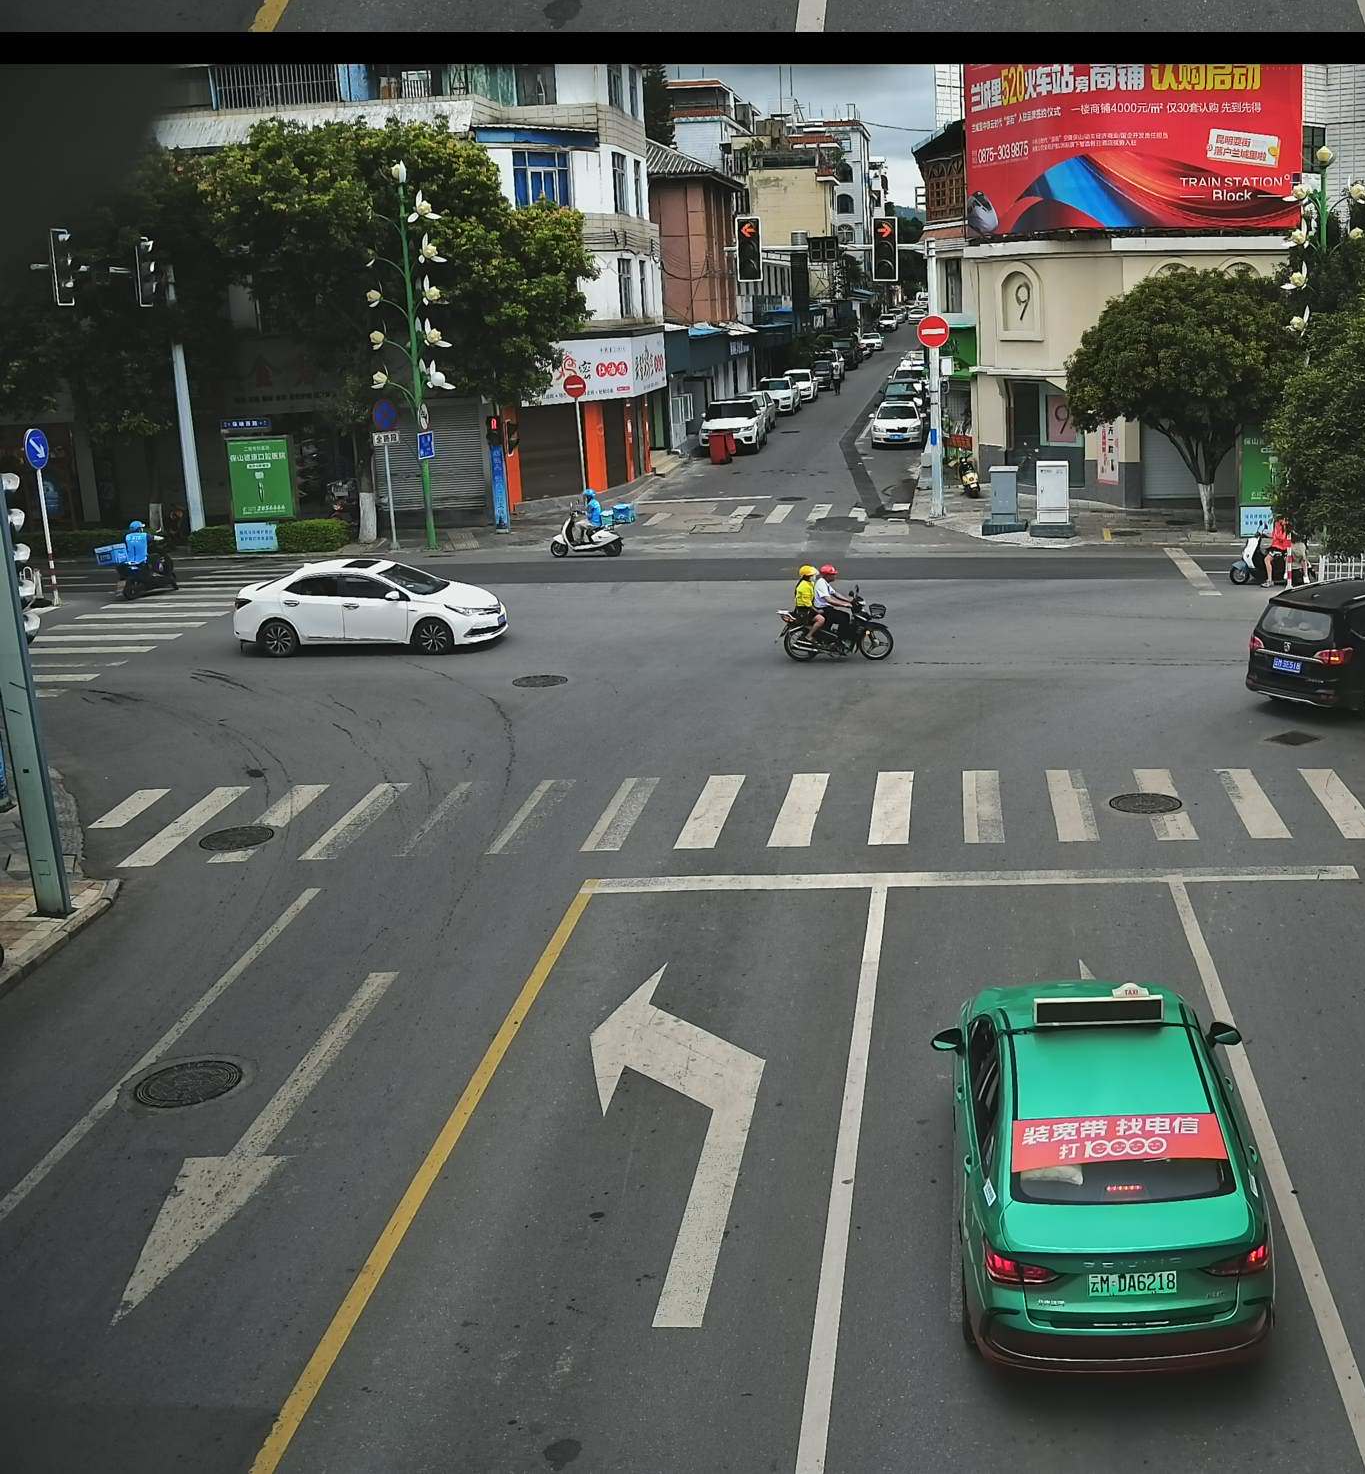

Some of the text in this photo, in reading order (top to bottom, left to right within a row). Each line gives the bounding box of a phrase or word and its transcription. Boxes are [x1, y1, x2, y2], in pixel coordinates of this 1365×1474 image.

[1221, 101, 1262, 114] 先到先得
[1180, 177, 1283, 187] TRAIN STATION
[1212, 189, 1252, 201] Block
[1022, 1116, 1200, 1146] 装宽带 找电信
[1058, 1137, 1168, 1160] 打 10000
